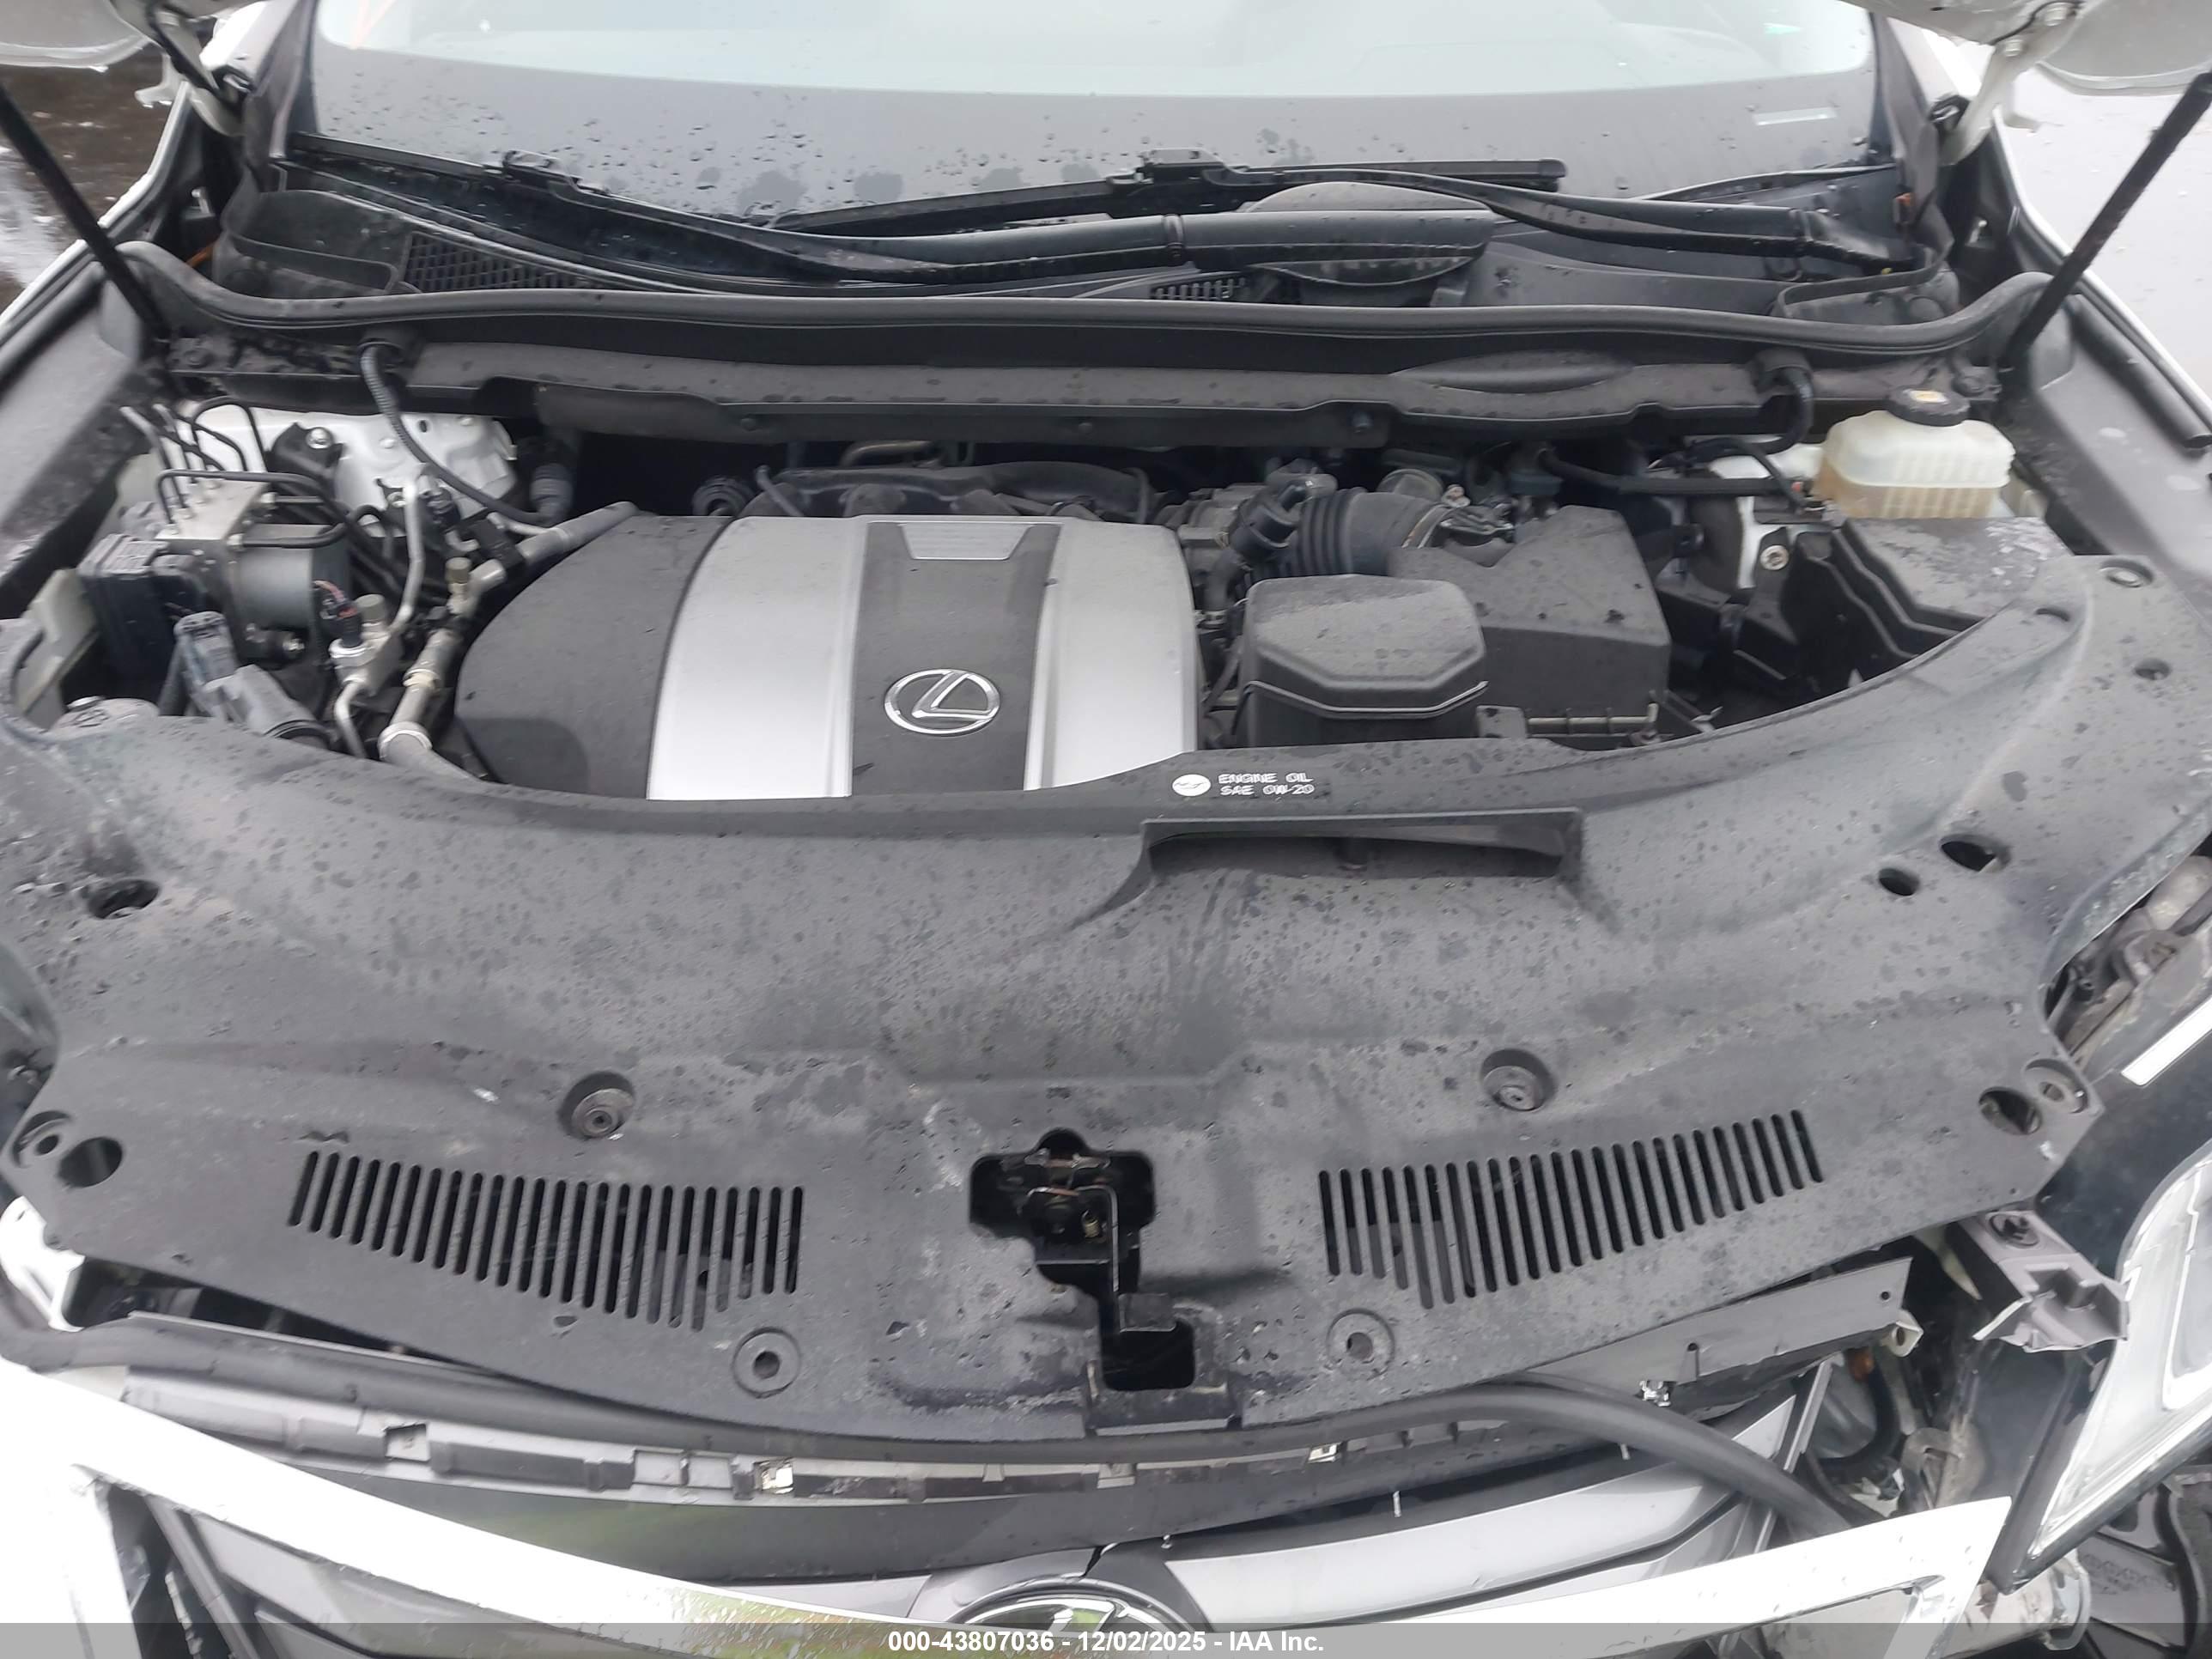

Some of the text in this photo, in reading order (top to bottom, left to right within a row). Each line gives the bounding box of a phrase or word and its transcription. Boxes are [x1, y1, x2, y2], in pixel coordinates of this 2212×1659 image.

[1218, 772, 1314, 784] ENGINE OIL
[1220, 784, 1315, 795] SAE 0W-20
